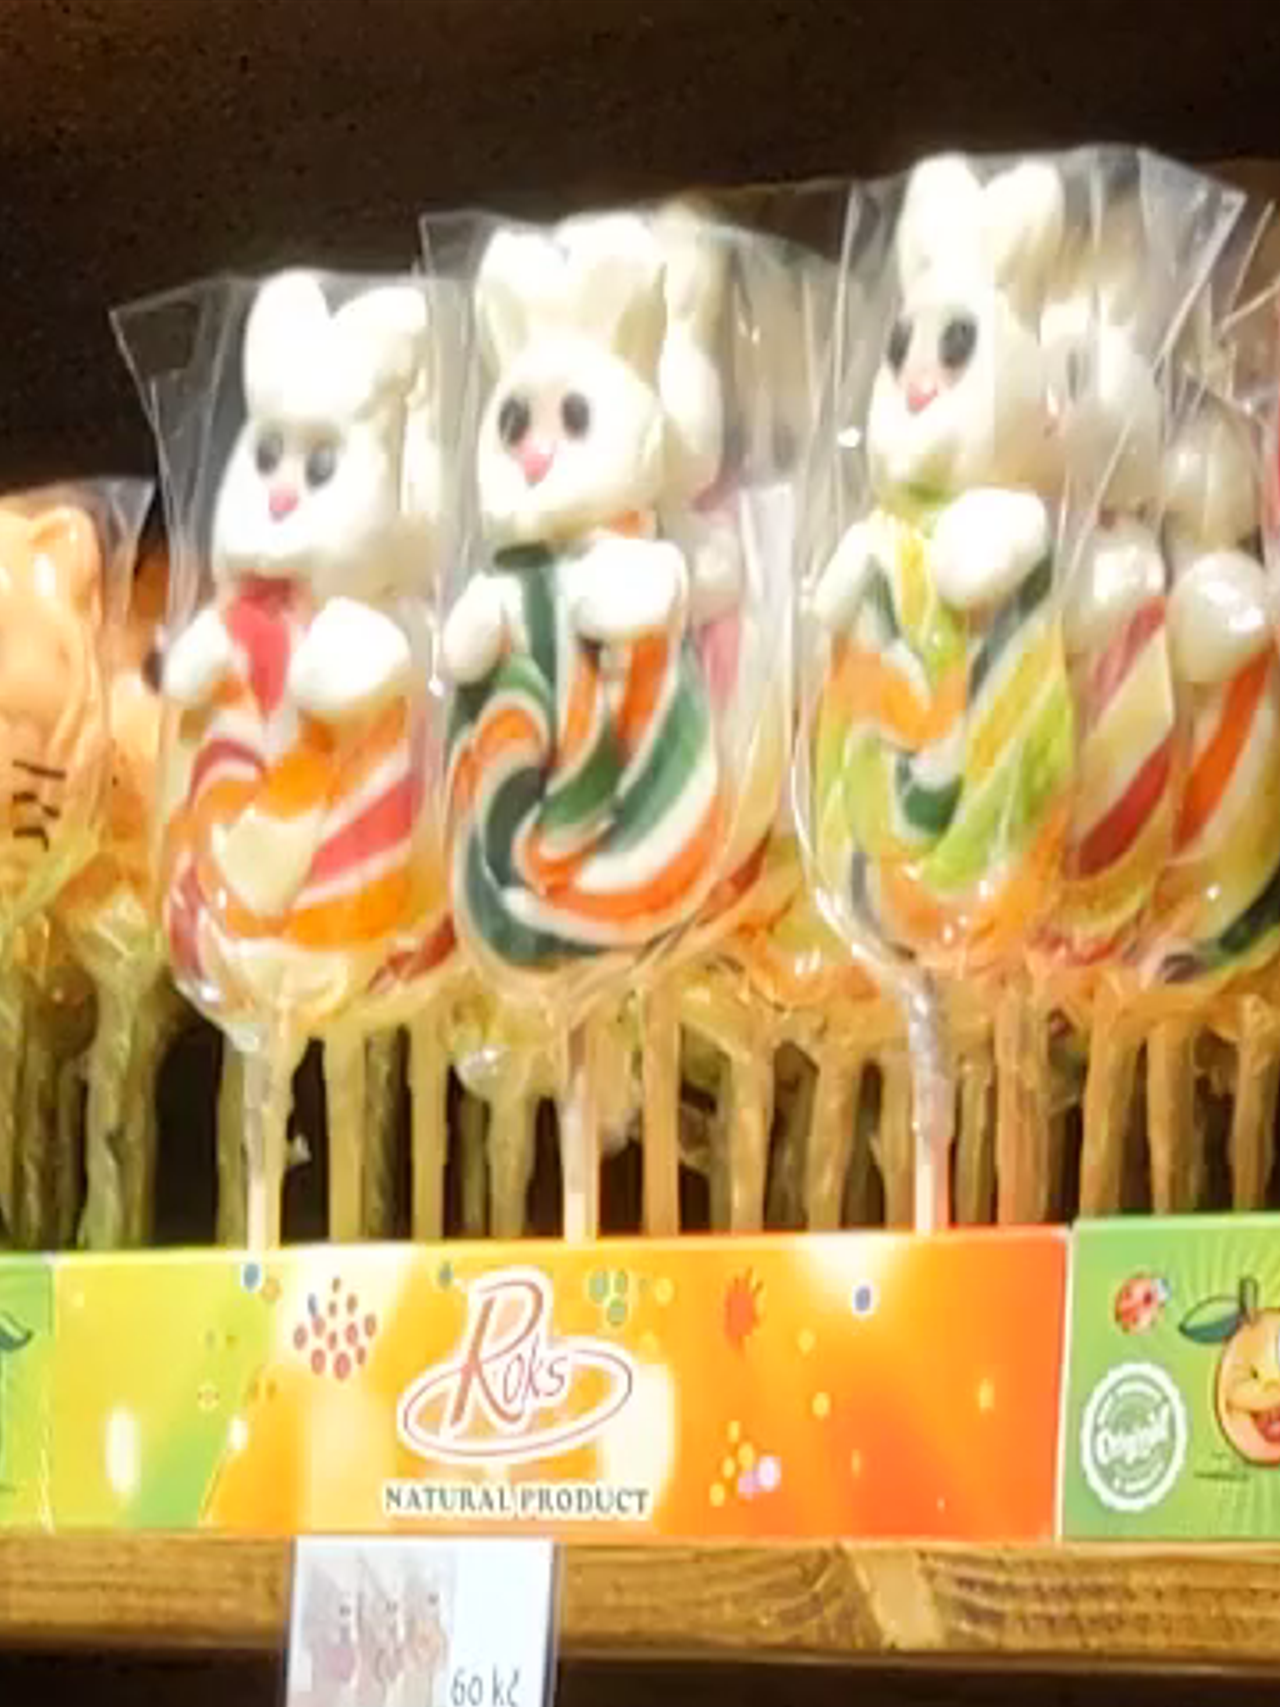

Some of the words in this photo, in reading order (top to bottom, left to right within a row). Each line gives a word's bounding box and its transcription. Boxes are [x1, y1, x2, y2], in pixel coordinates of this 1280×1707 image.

[385, 1485, 510, 1512] NATURAL
[520, 1486, 650, 1513] PRODUCT
[450, 1666, 483, 1707] 60
